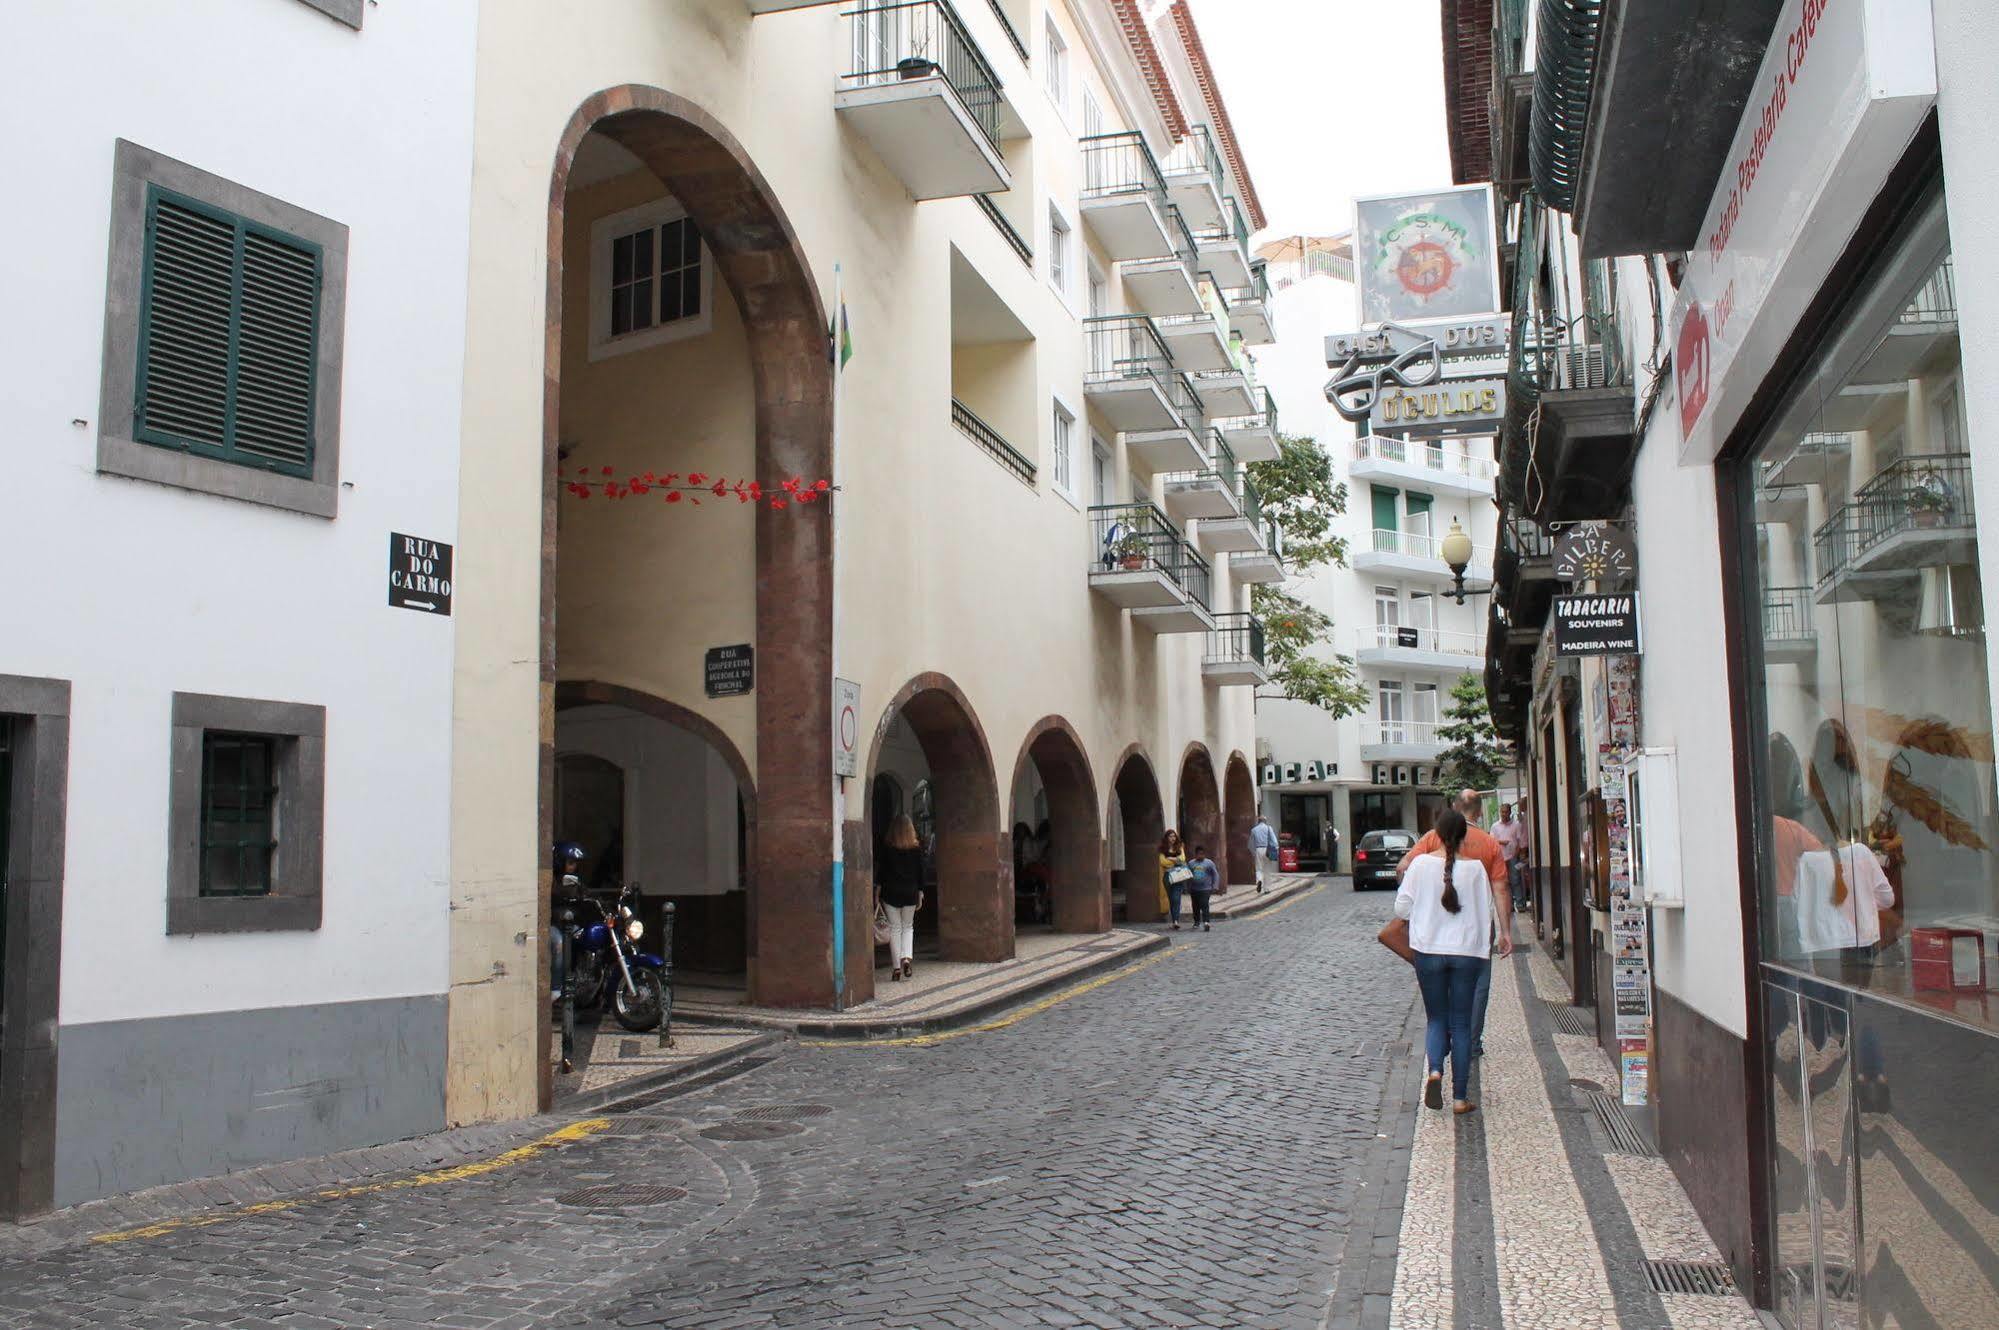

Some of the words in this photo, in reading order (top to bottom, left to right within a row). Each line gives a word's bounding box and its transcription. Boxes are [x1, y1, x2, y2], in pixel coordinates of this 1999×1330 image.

[1708, 190, 1739, 273] Padaria
[1738, 73, 1786, 206] Pastelaria
[1333, 333, 1395, 356] CASA
[1444, 325, 1497, 347] DOS
[404, 537, 439, 560] RUA
[410, 555, 434, 575] DO
[391, 570, 451, 597] CARMO
[1558, 598, 1630, 617] TABACARIA
[1568, 619, 1624, 629] SOUVENIRS
[1562, 641, 1606, 651] MADEIRA
[1607, 639, 1634, 649] WINE
